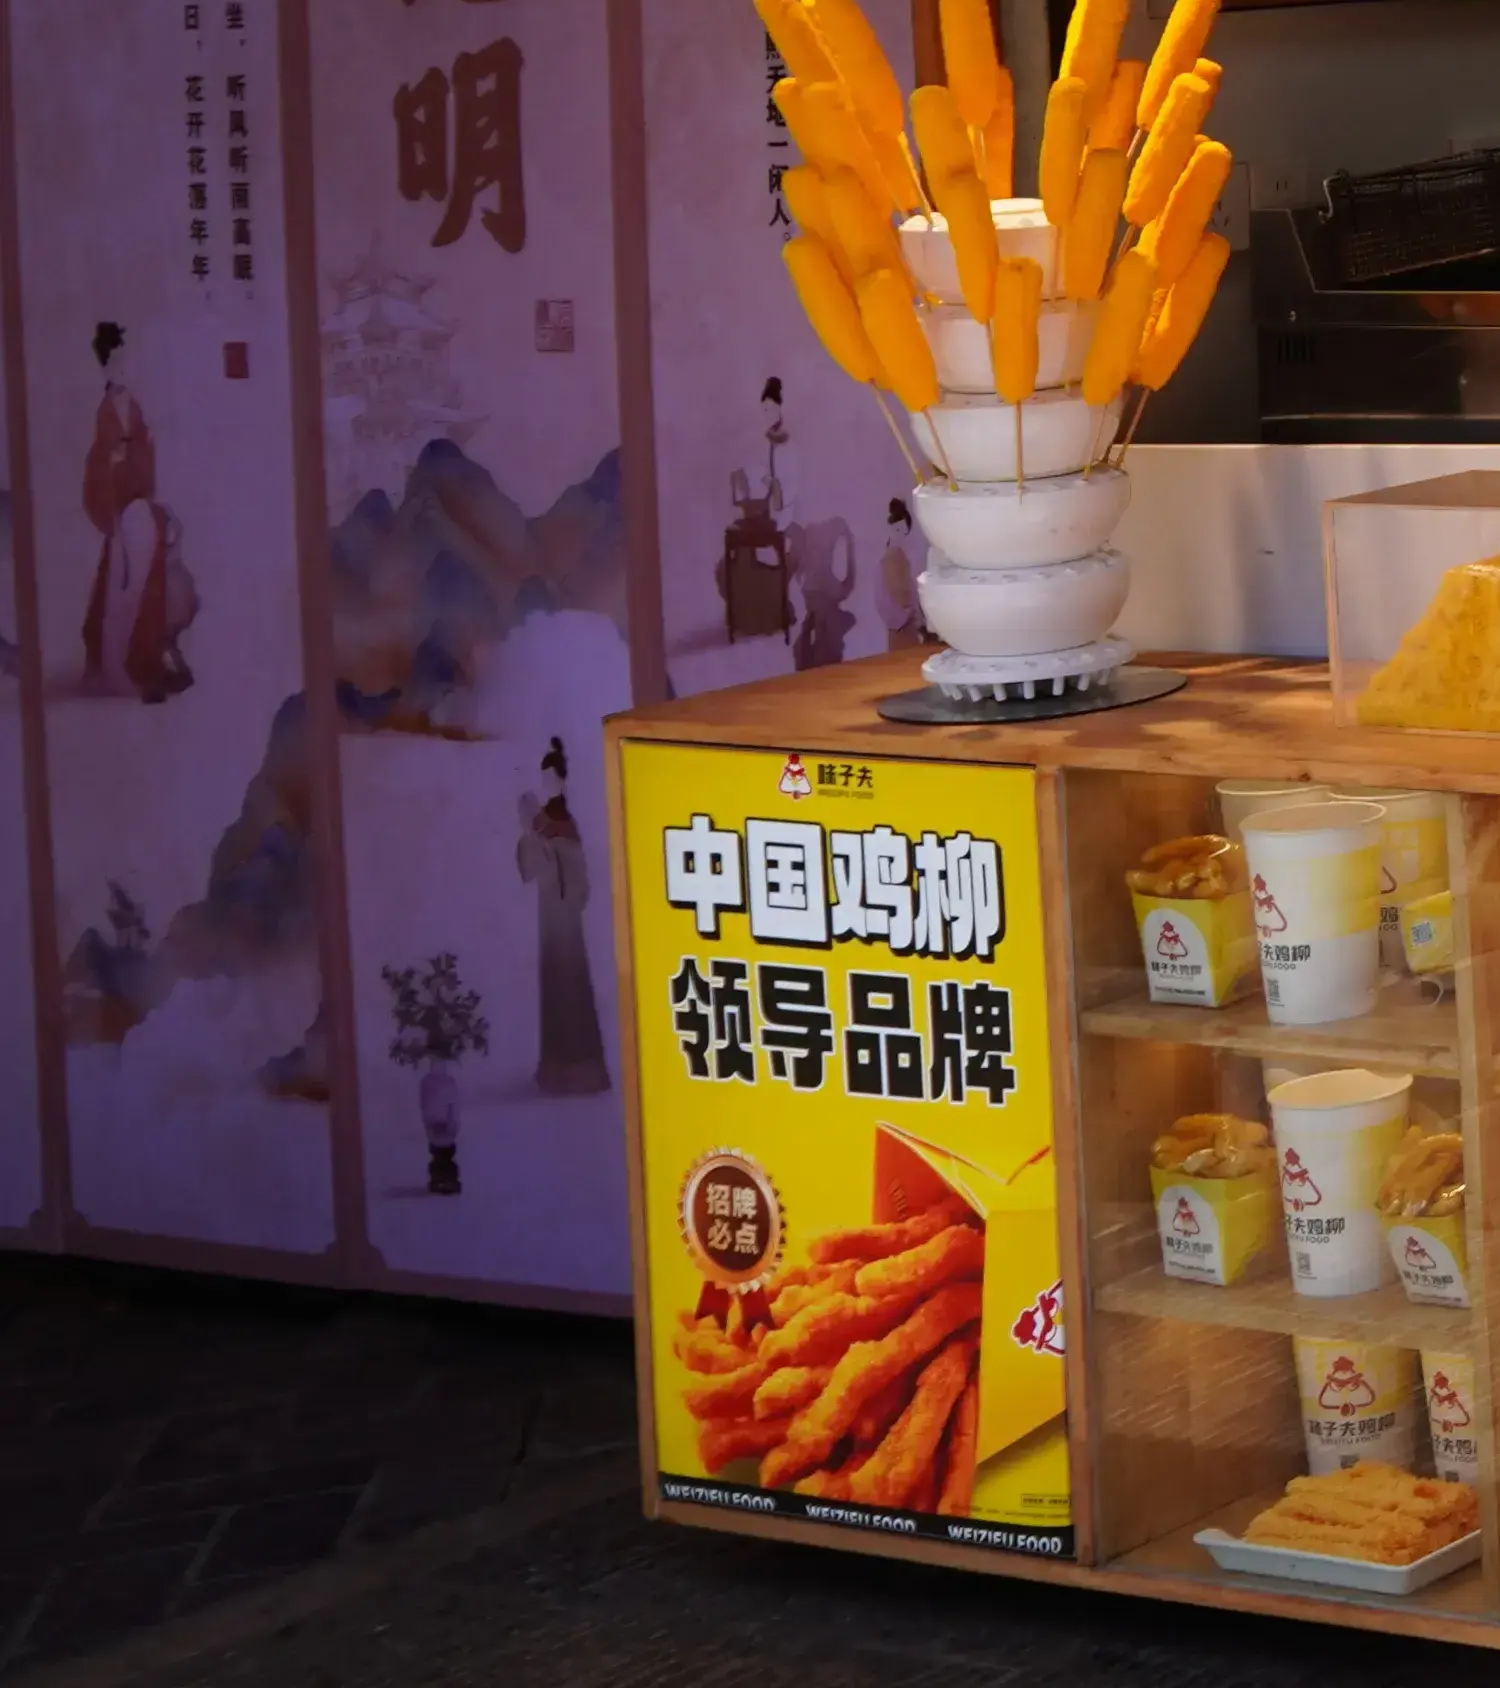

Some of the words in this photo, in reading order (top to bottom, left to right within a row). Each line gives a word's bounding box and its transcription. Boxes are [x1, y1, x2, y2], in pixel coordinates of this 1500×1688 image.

[817, 763, 874, 788] 味子夫
[664, 813, 1004, 960] 中国鸡柳
[669, 958, 1018, 1107] 领导品牌
[706, 1183, 758, 1223] 招牌
[706, 1218, 761, 1256] 必点
